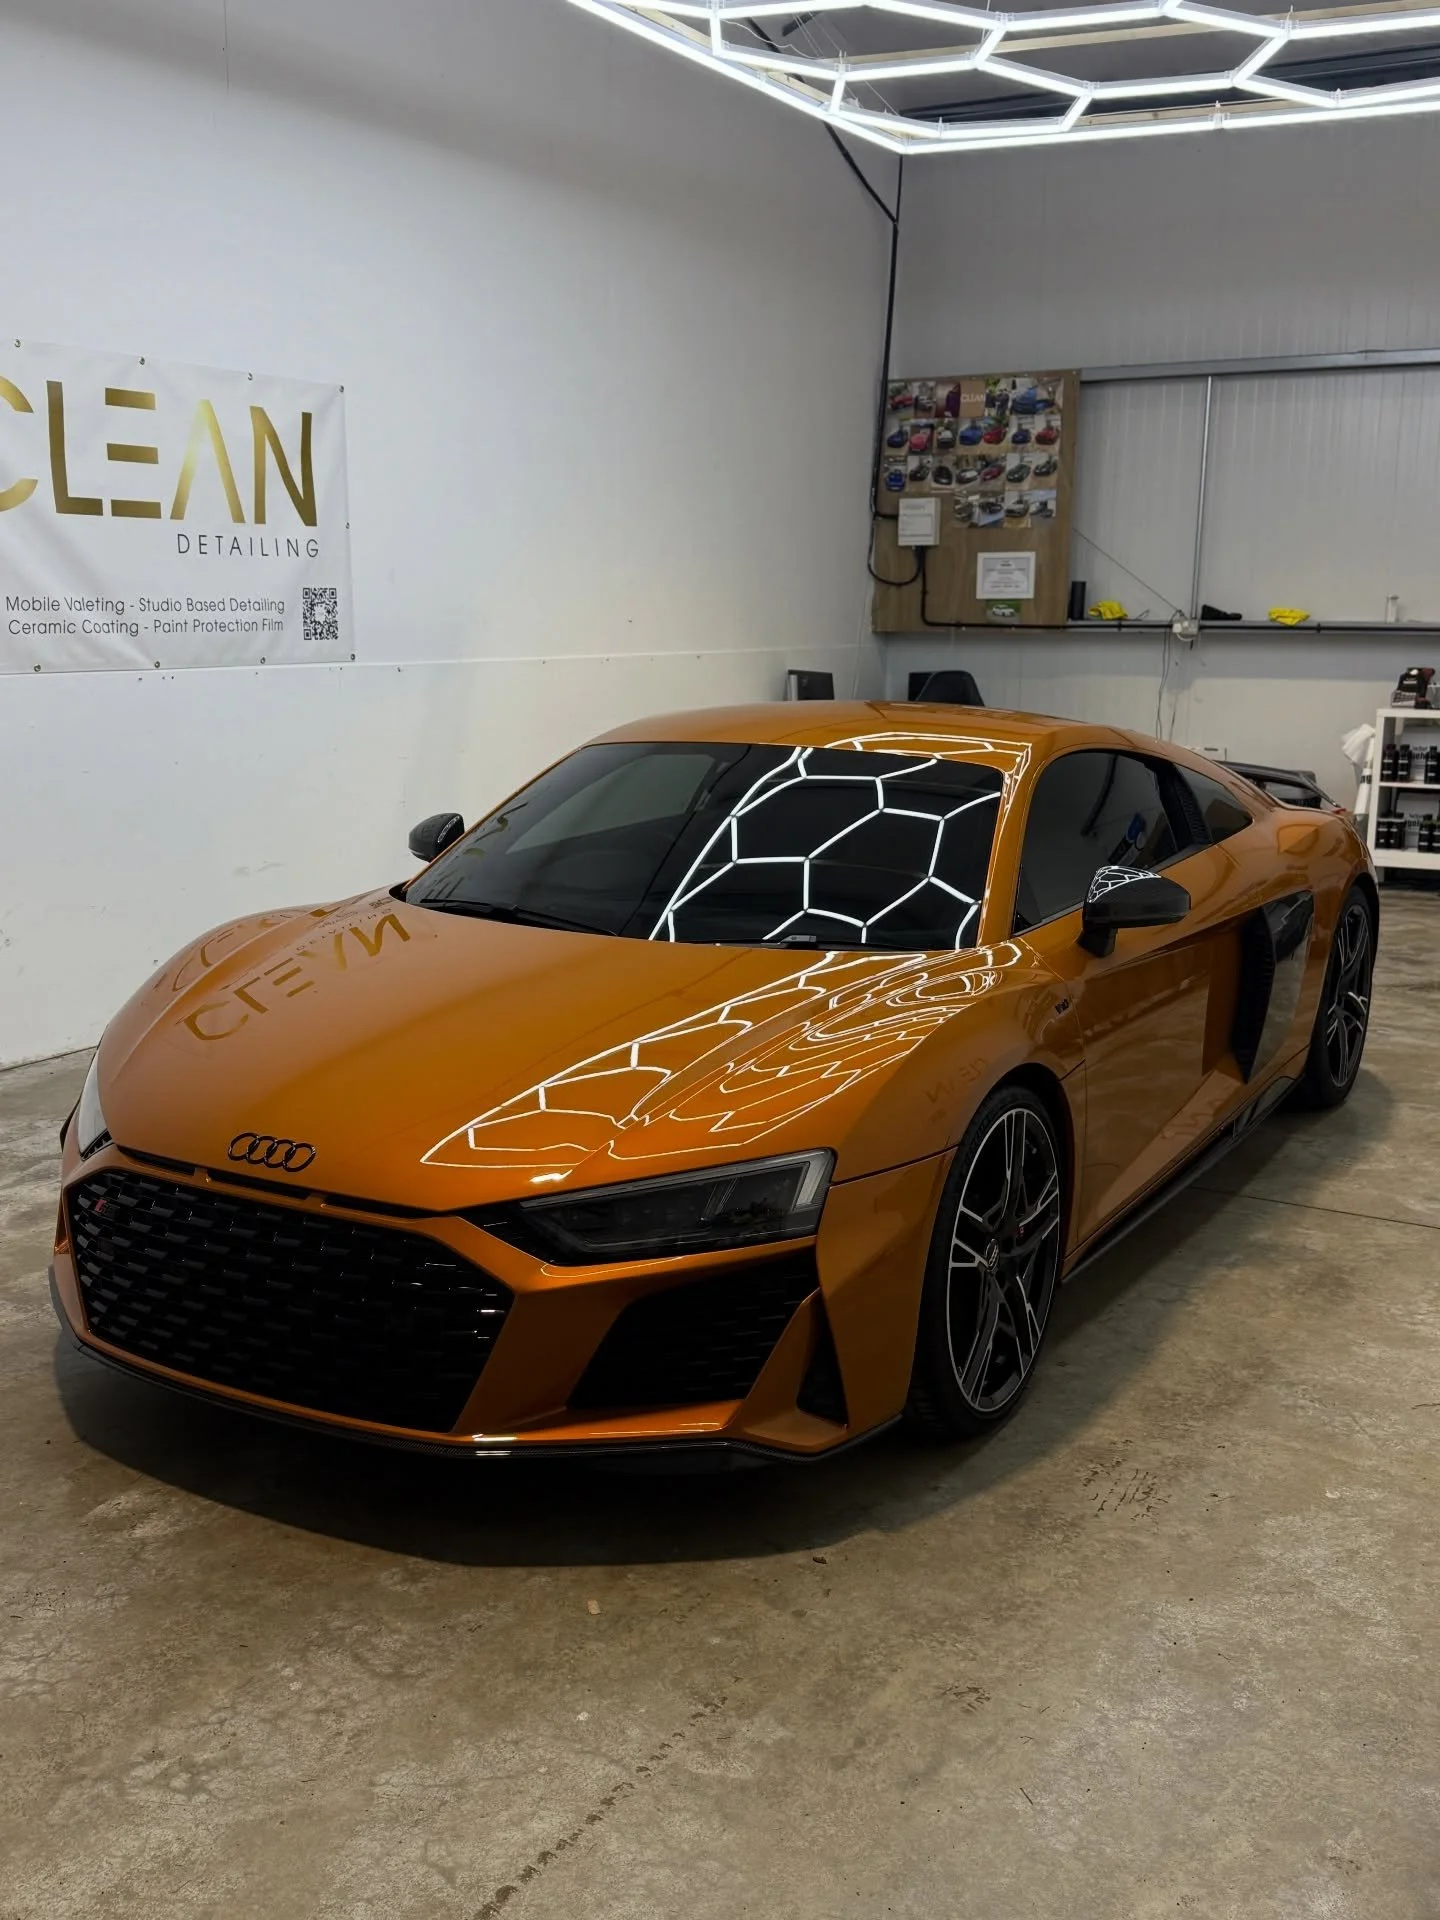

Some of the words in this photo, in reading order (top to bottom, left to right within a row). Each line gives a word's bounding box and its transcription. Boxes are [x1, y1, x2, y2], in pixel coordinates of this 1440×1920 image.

[177, 533, 319, 558] DETAILING
[6, 596, 60, 612] Mobile
[63, 597, 125, 615] Valeting
[138, 597, 182, 612] Studio
[186, 598, 226, 612] Based
[230, 598, 286, 614] Detailing
[8, 619, 77, 635] Ceramic
[82, 619, 138, 637] Coating
[154, 618, 188, 633] Paint
[192, 617, 258, 632] Protection
[262, 617, 284, 631] Film
